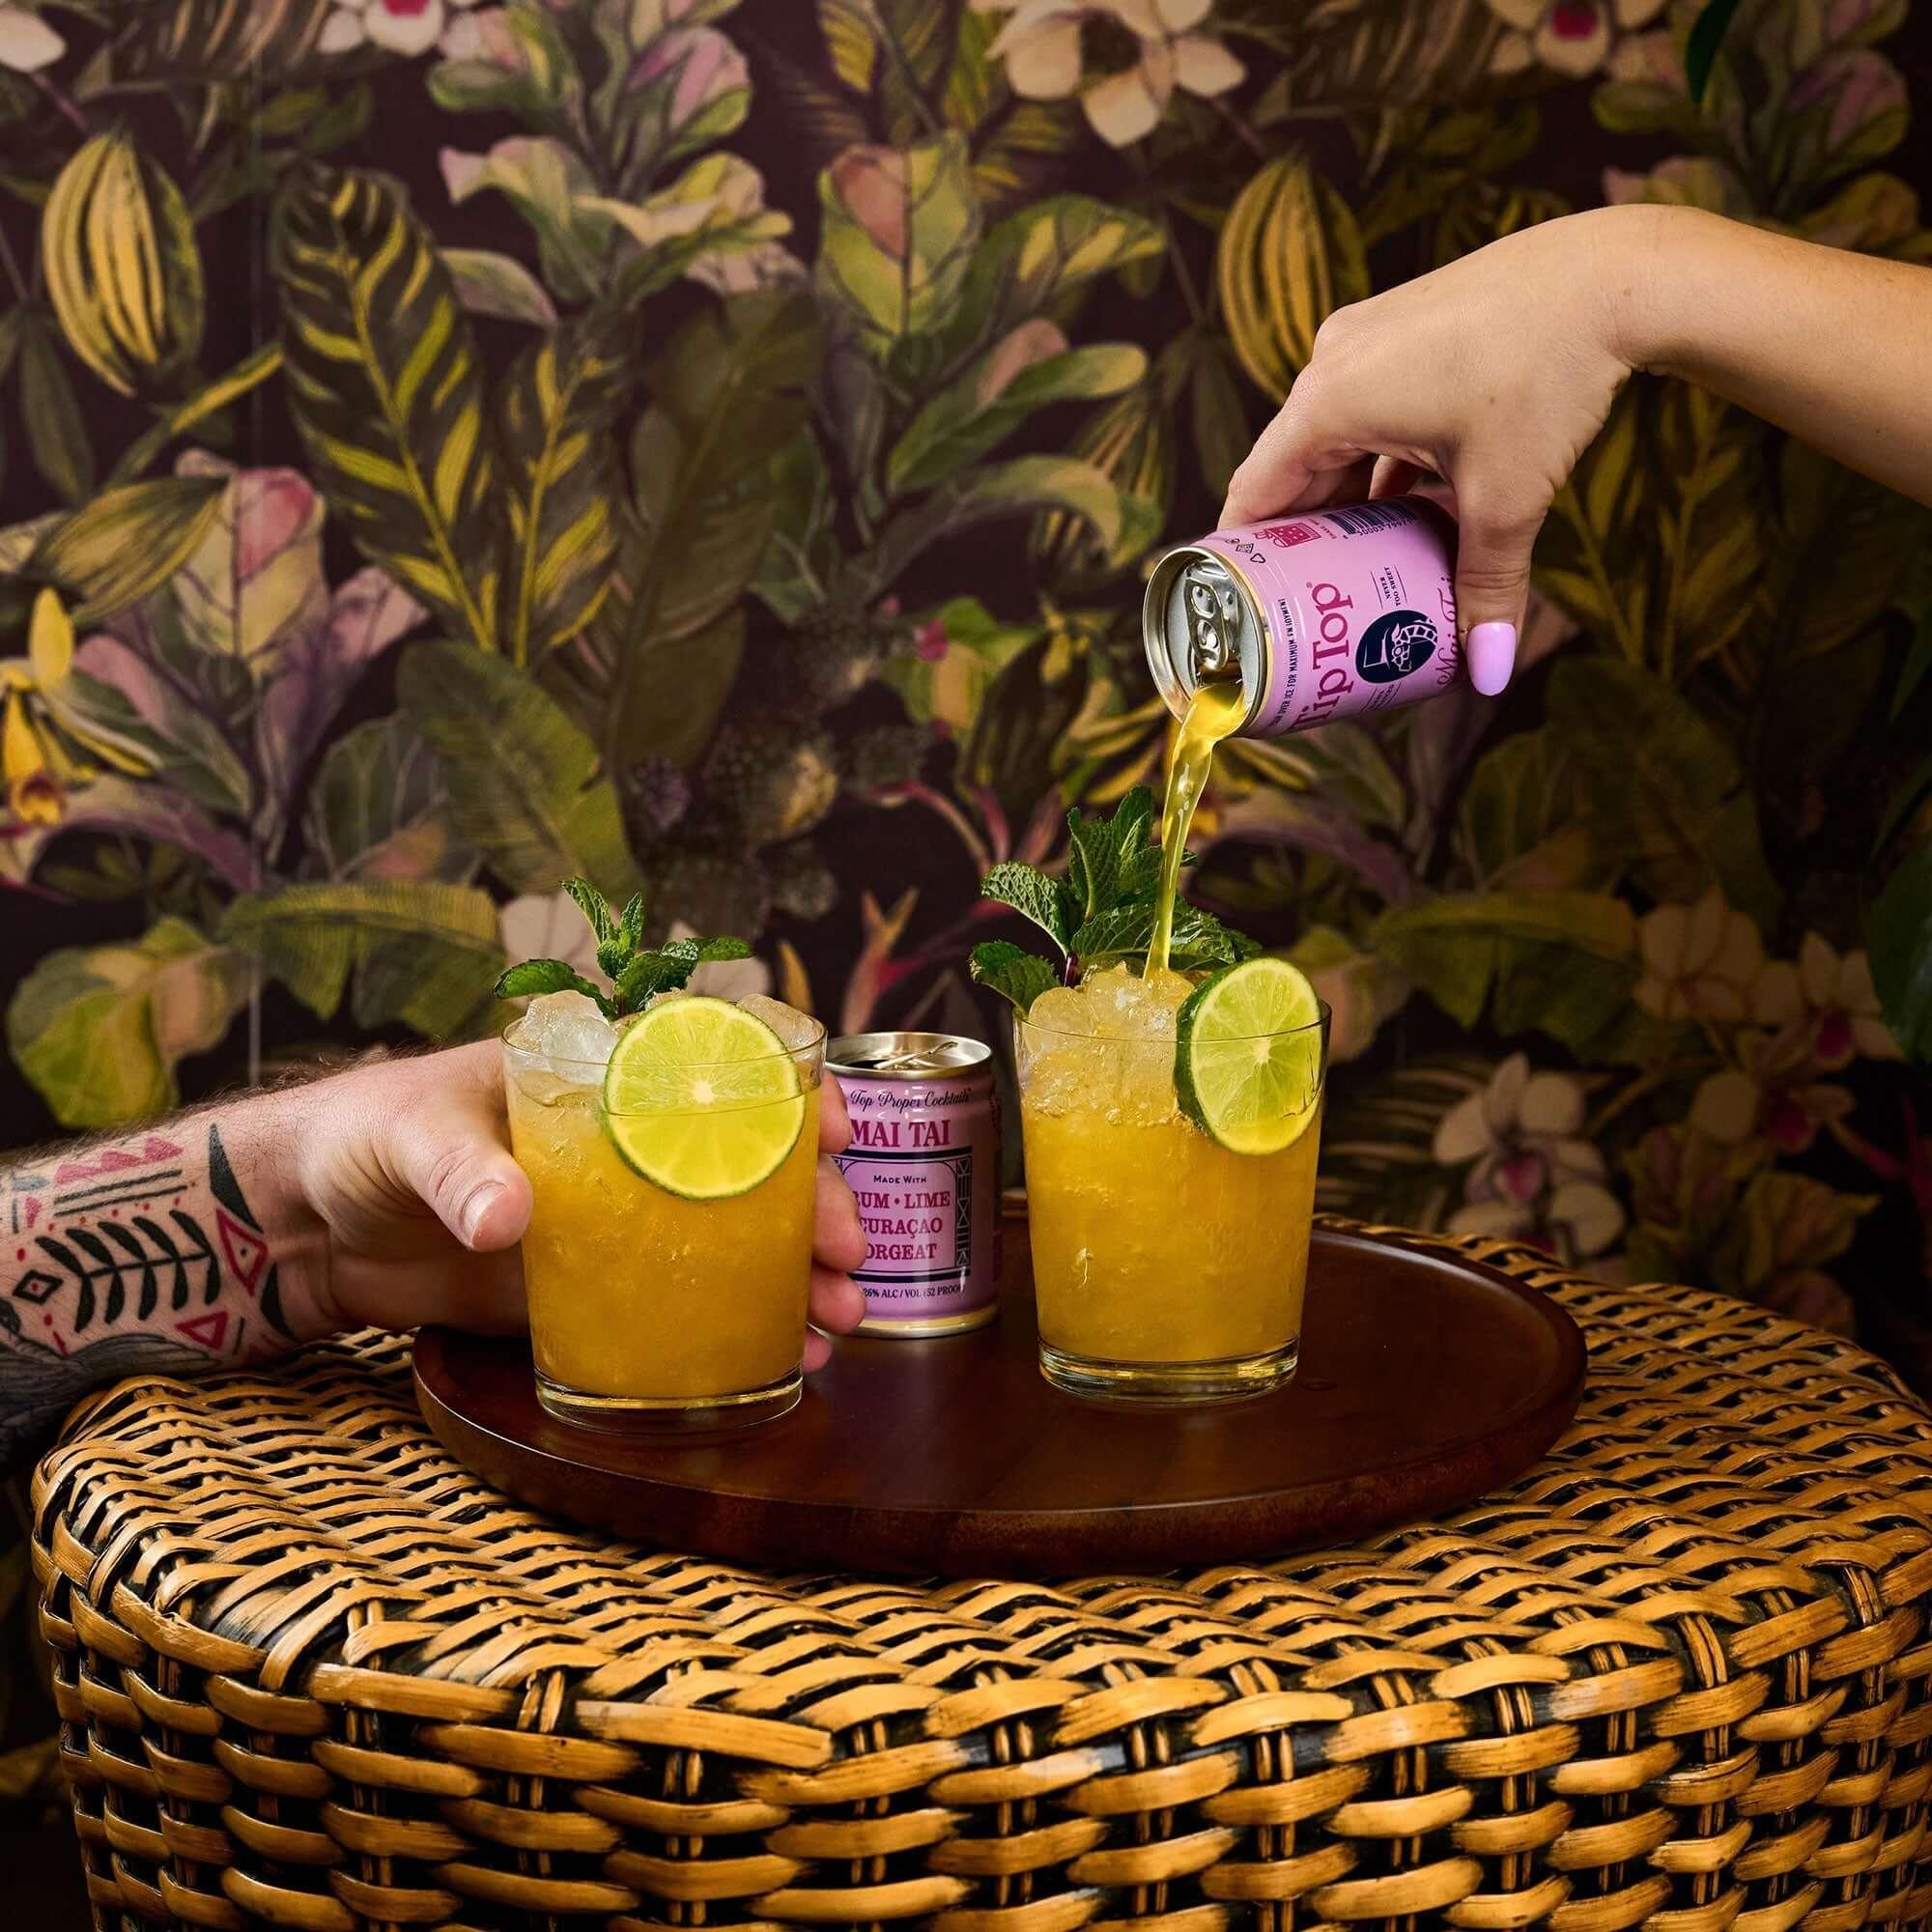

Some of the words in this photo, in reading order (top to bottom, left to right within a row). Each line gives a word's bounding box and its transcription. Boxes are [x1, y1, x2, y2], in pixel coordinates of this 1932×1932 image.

[1379, 577, 1391, 600] NEVER
[1384, 566, 1397, 591] SWEET
[1312, 582, 1354, 670] Top
[1287, 639, 1298, 671] MAXIMUM
[1287, 673, 1297, 687] FOR
[1284, 689, 1295, 699] ICE
[1288, 668, 1354, 732] Tip
[1277, 700, 1291, 715] OVER
[850, 1090, 874, 1112] Top
[878, 1093, 922, 1114] Proper
[850, 1119, 900, 1147] MAI
[908, 1120, 951, 1147] TAI
[904, 1191, 951, 1209] LIME
[859, 1217, 944, 1238] CURAÇAO
[866, 1243, 938, 1261] ORGEAT
[863, 1287, 880, 1298] 26%
[881, 1289, 898, 1298] ALC
[904, 1288, 922, 1298] VOL
